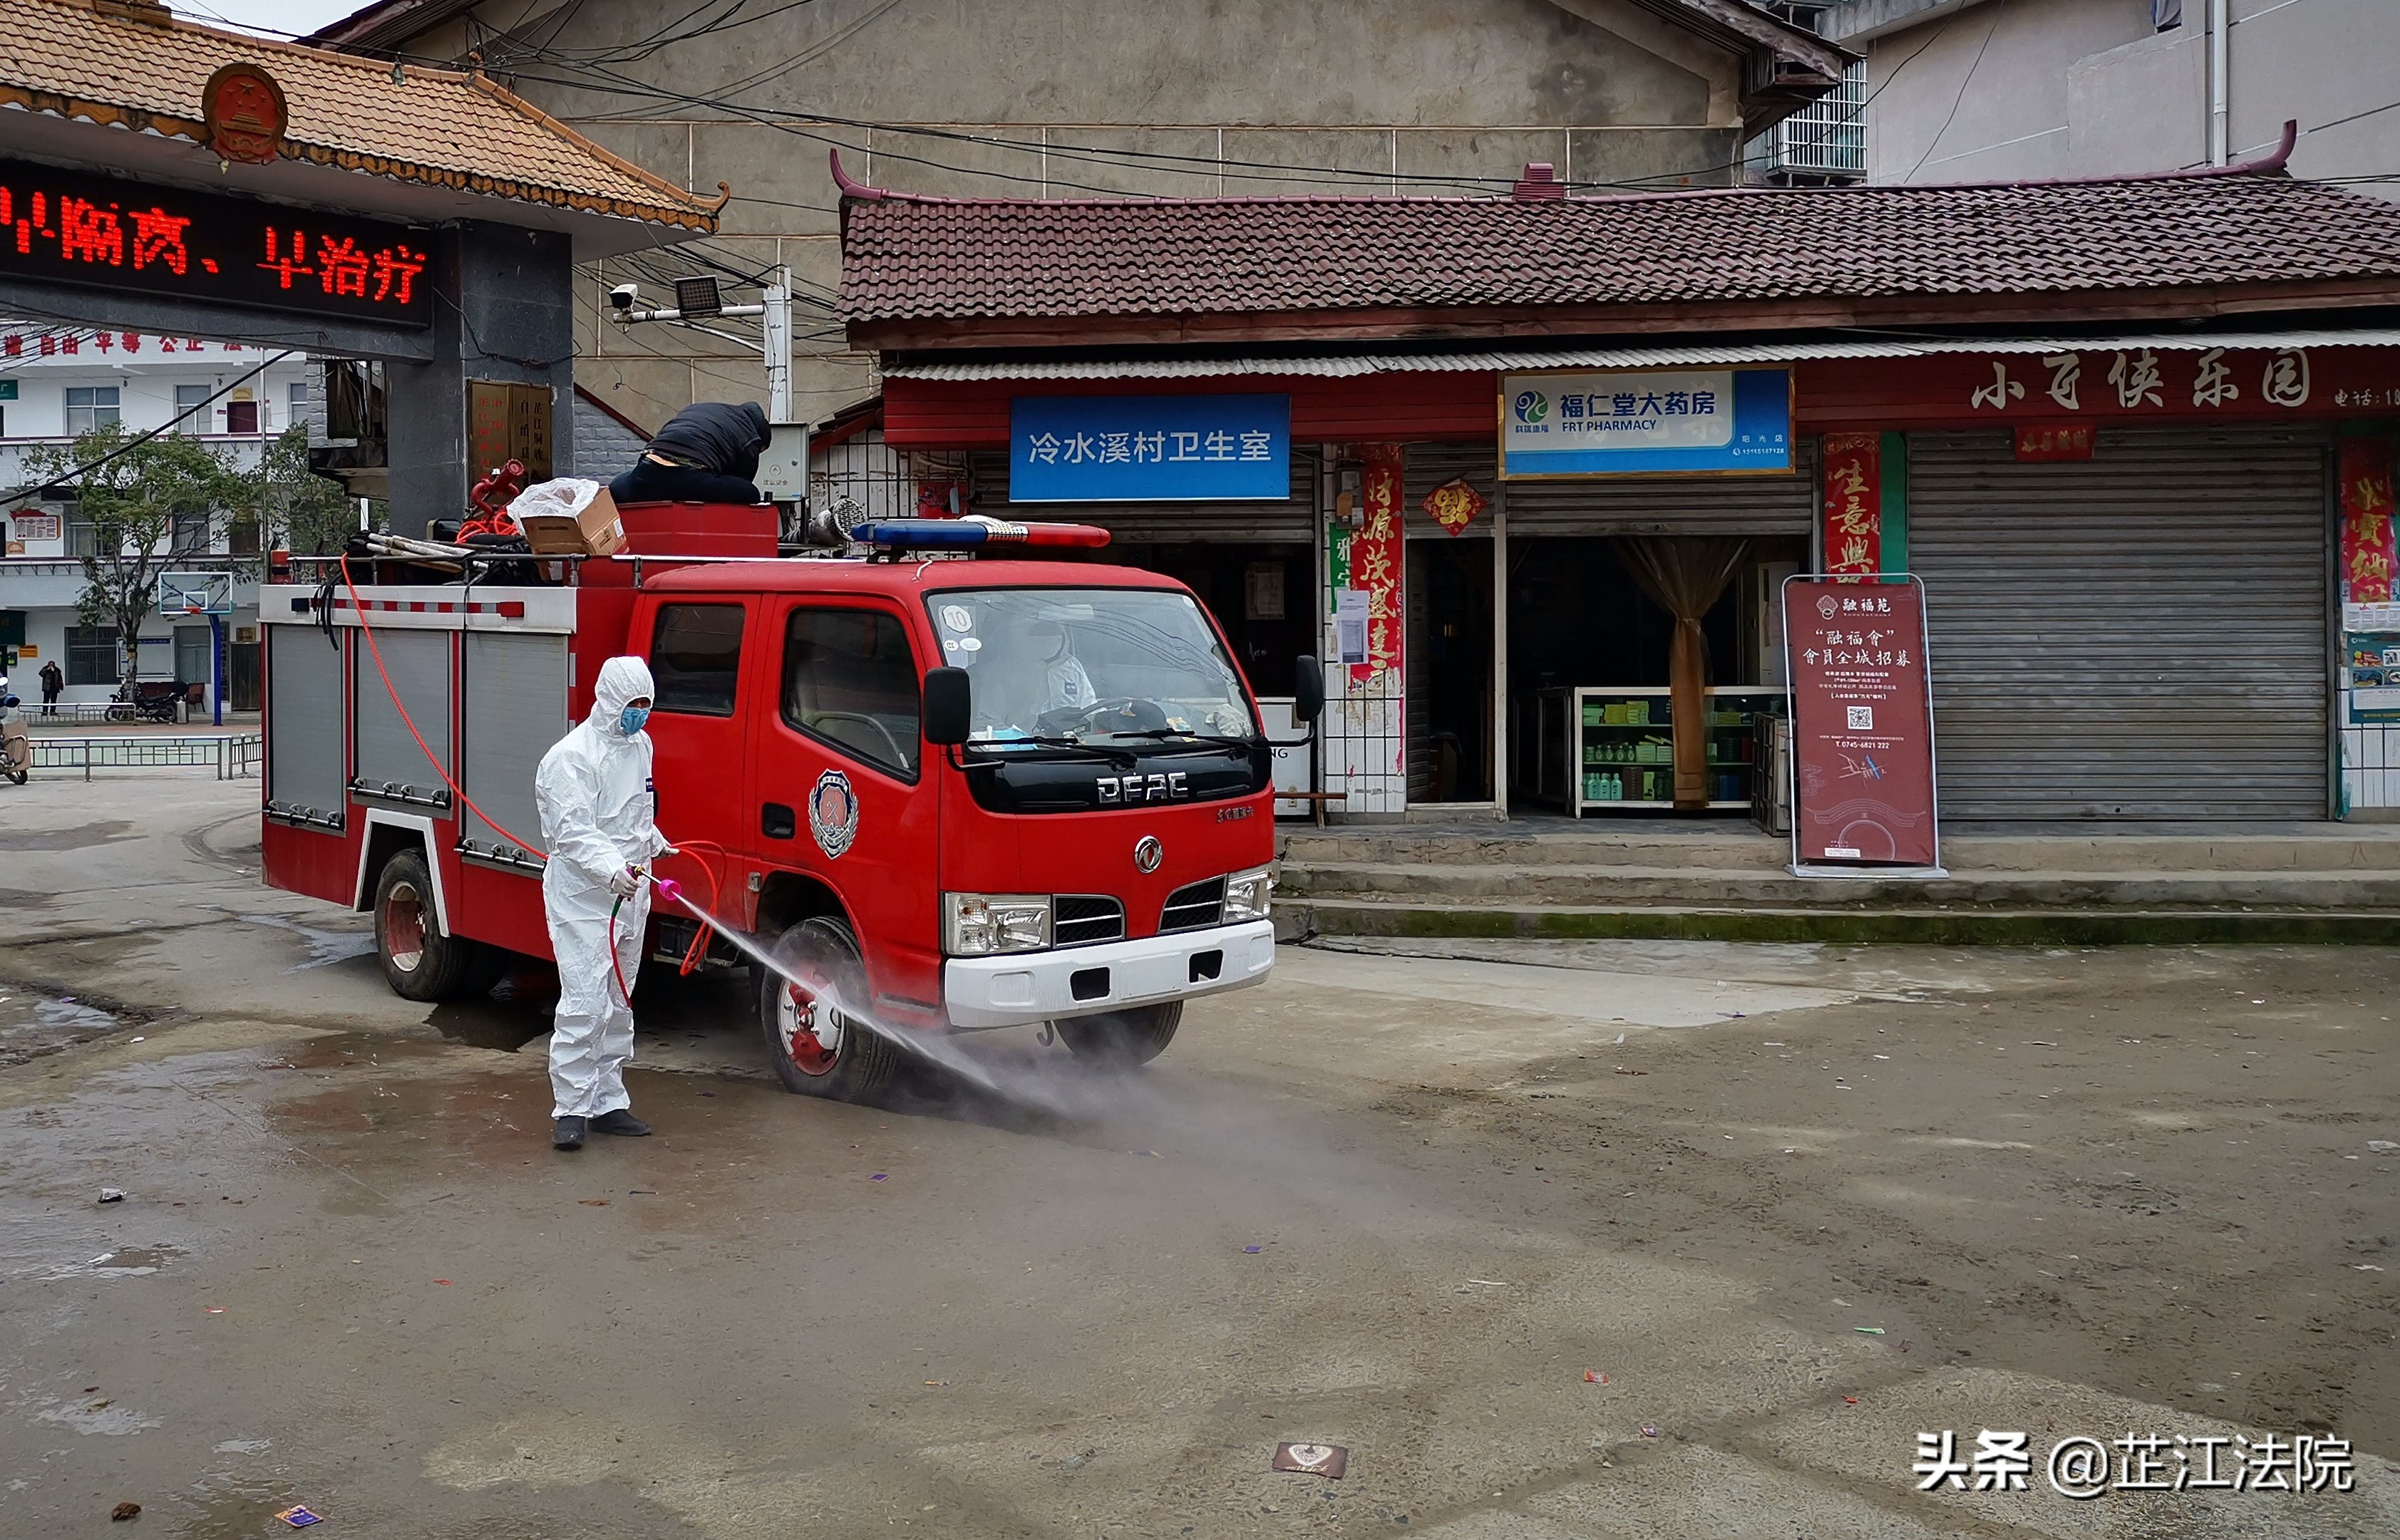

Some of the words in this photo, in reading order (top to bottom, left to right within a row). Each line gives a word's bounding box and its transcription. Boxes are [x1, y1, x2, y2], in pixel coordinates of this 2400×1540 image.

[41, 334, 78, 356] 自由
[95, 331, 141, 354] 平等
[1560, 391, 1715, 418] 福仁堂大药房
[1562, 422, 1584, 433] FRT
[1587, 419, 1657, 432] PHARMACY
[1029, 430, 1272, 465] 冷水溪村卫生室
[1843, 598, 1891, 612] 融福苑
[1802, 648, 1912, 667] 會員全城招募
[1096, 772, 1189, 804] DFAC
